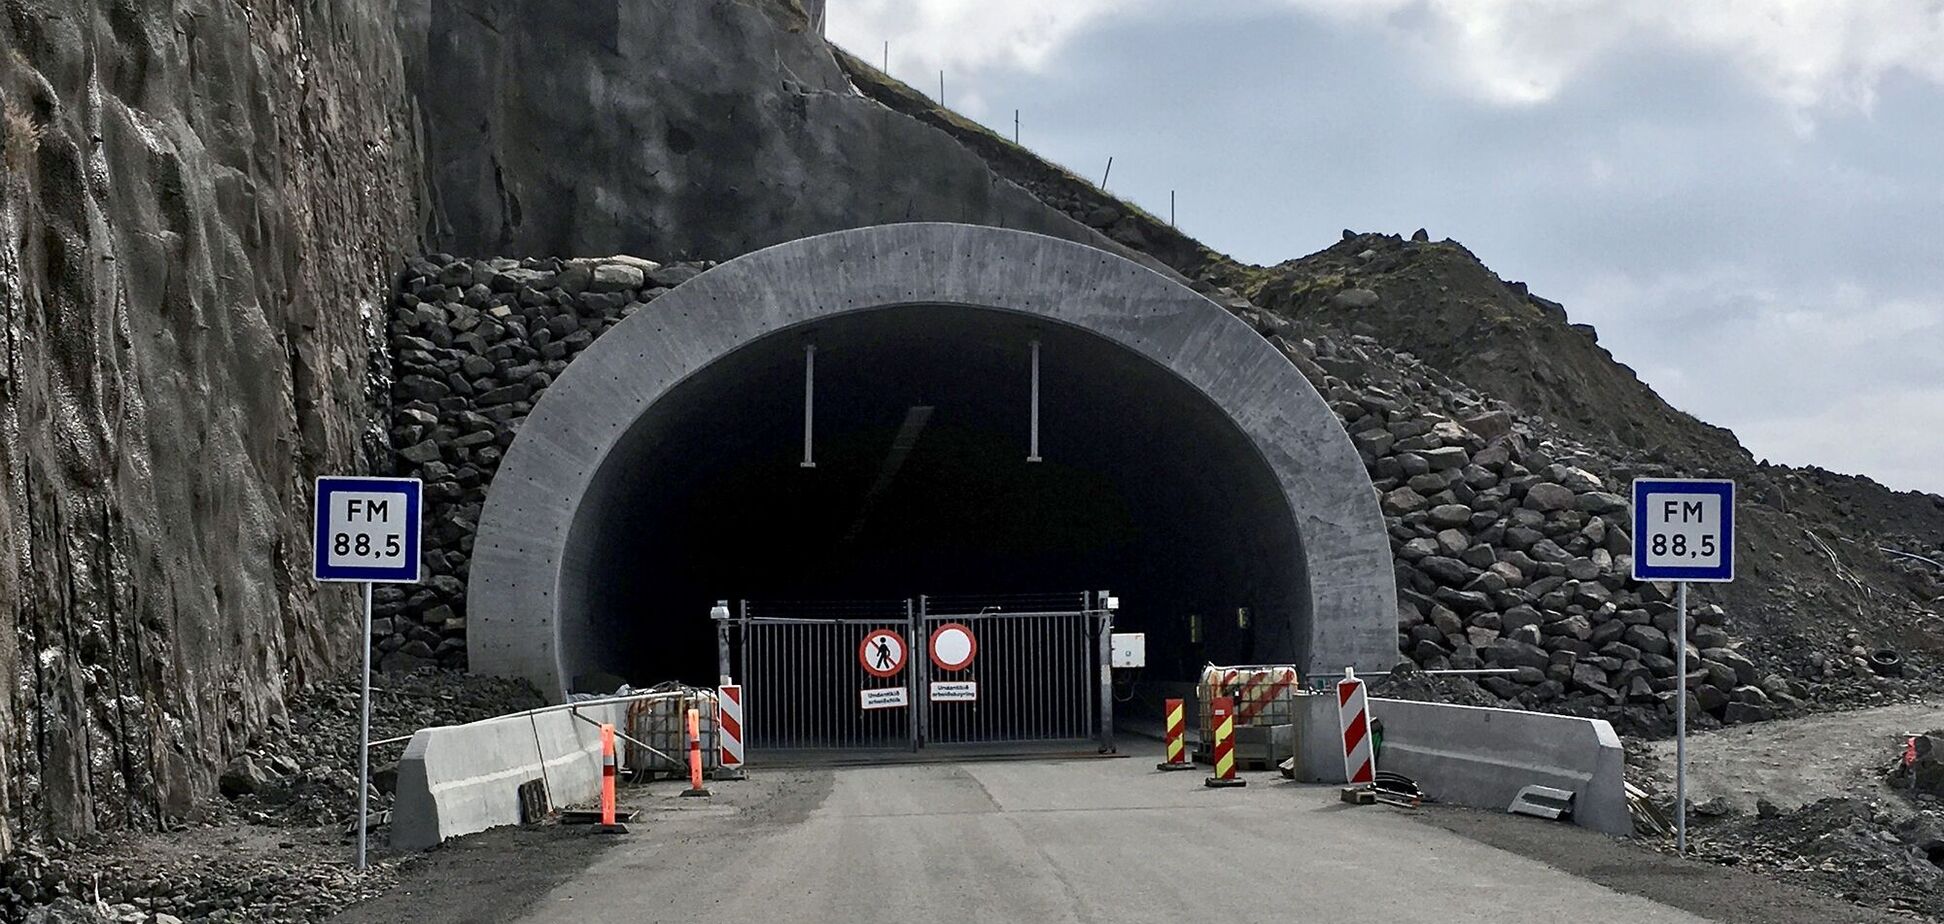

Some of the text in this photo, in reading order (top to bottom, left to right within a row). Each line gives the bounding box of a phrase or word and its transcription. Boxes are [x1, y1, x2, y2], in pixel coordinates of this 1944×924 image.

[347, 499, 388, 522] FM
[1664, 501, 1703, 523] FM
[334, 533, 400, 559] 88,5
[1652, 533, 1715, 559] 88,5
[868, 690, 900, 698] Undankið
